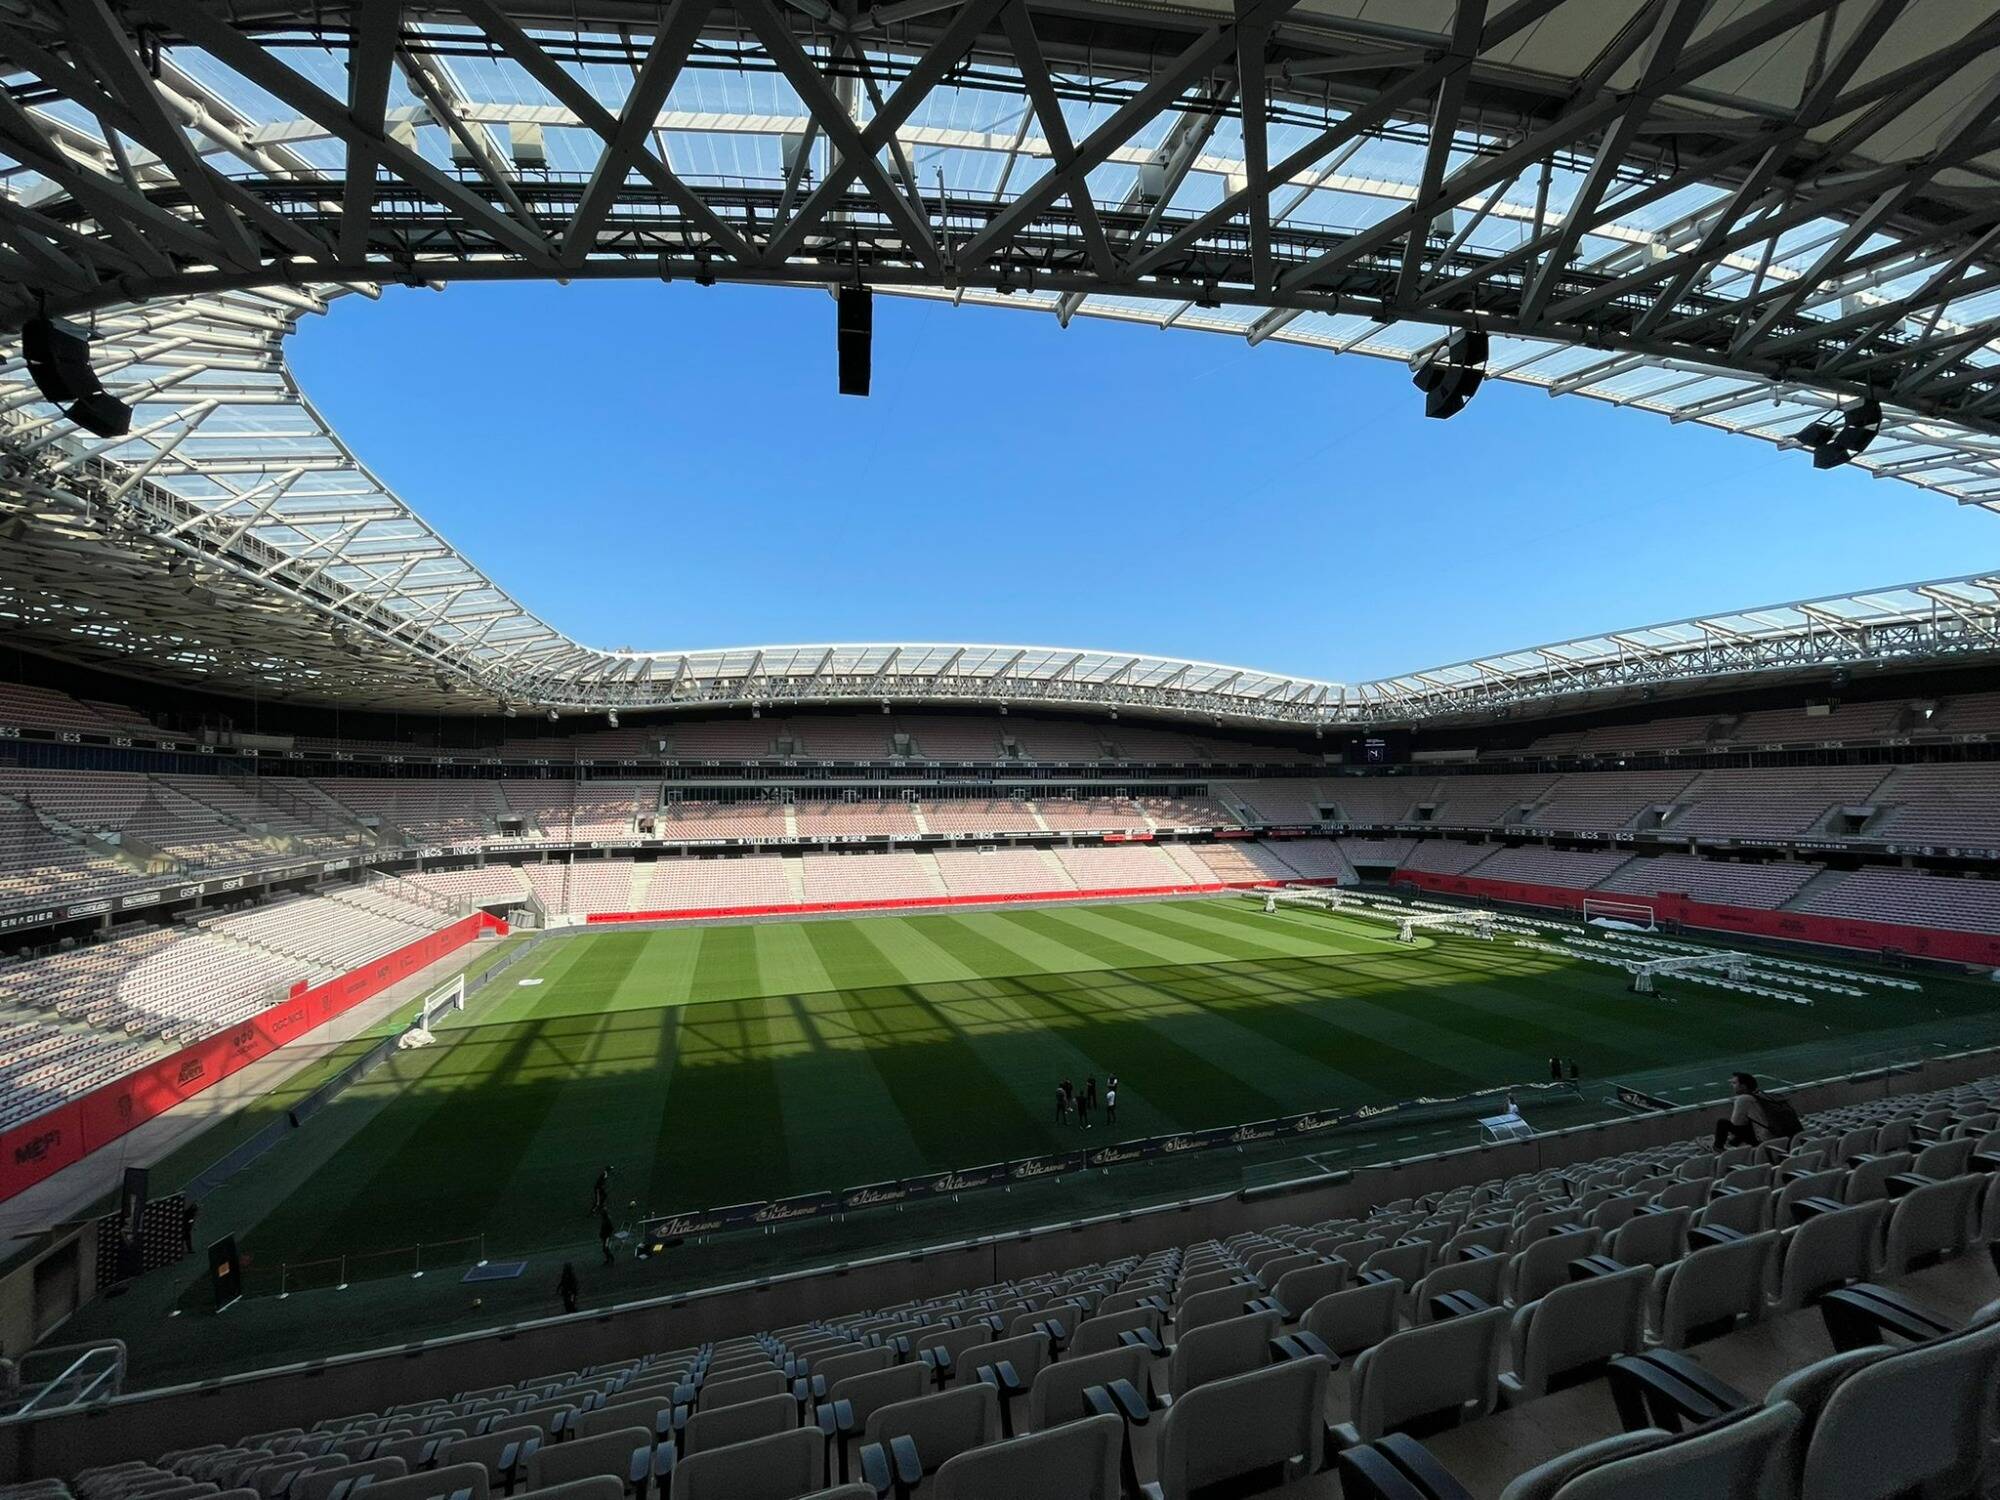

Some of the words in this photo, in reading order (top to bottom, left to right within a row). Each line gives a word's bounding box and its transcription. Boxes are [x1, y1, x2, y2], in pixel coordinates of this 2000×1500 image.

[416, 848, 443, 858] INEOS
[453, 846, 481, 855] INEOS
[223, 880, 238, 890] GSF
[180, 887, 198, 898] GSF
